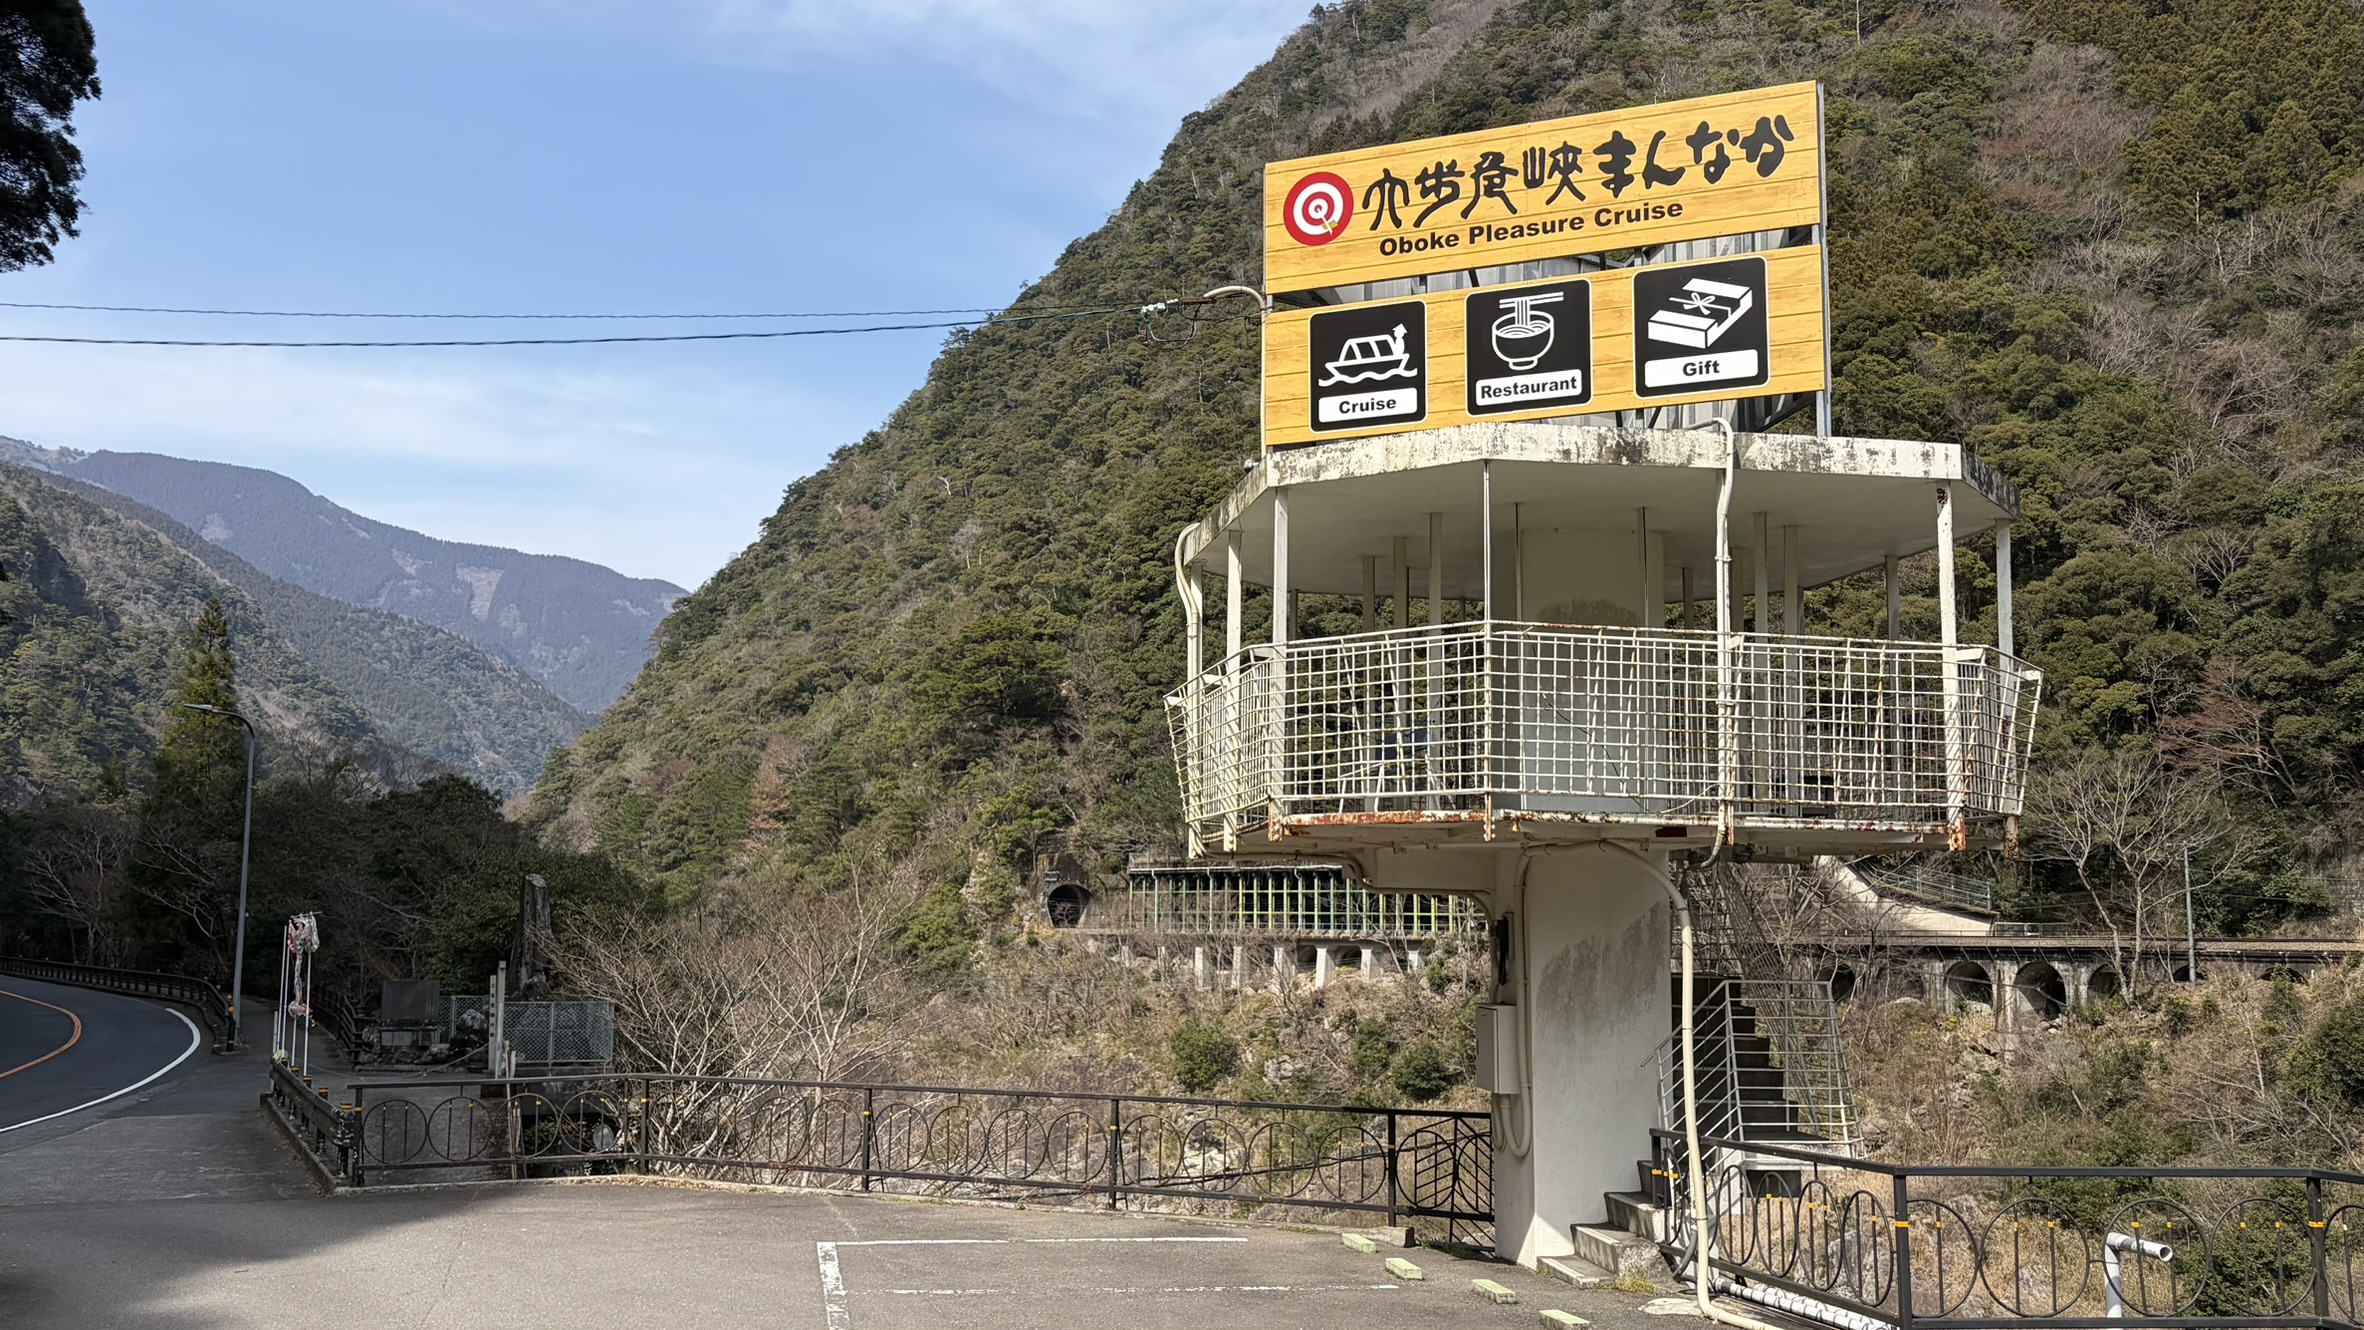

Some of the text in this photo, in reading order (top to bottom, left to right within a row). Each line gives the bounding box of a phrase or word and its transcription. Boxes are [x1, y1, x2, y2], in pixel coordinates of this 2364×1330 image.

[1379, 201, 1684, 257] Oboke Pleasure Cruise
[1682, 359, 1721, 377] Gift
[1480, 377, 1578, 399] Restaurant
[1338, 396, 1397, 415] Cruise
